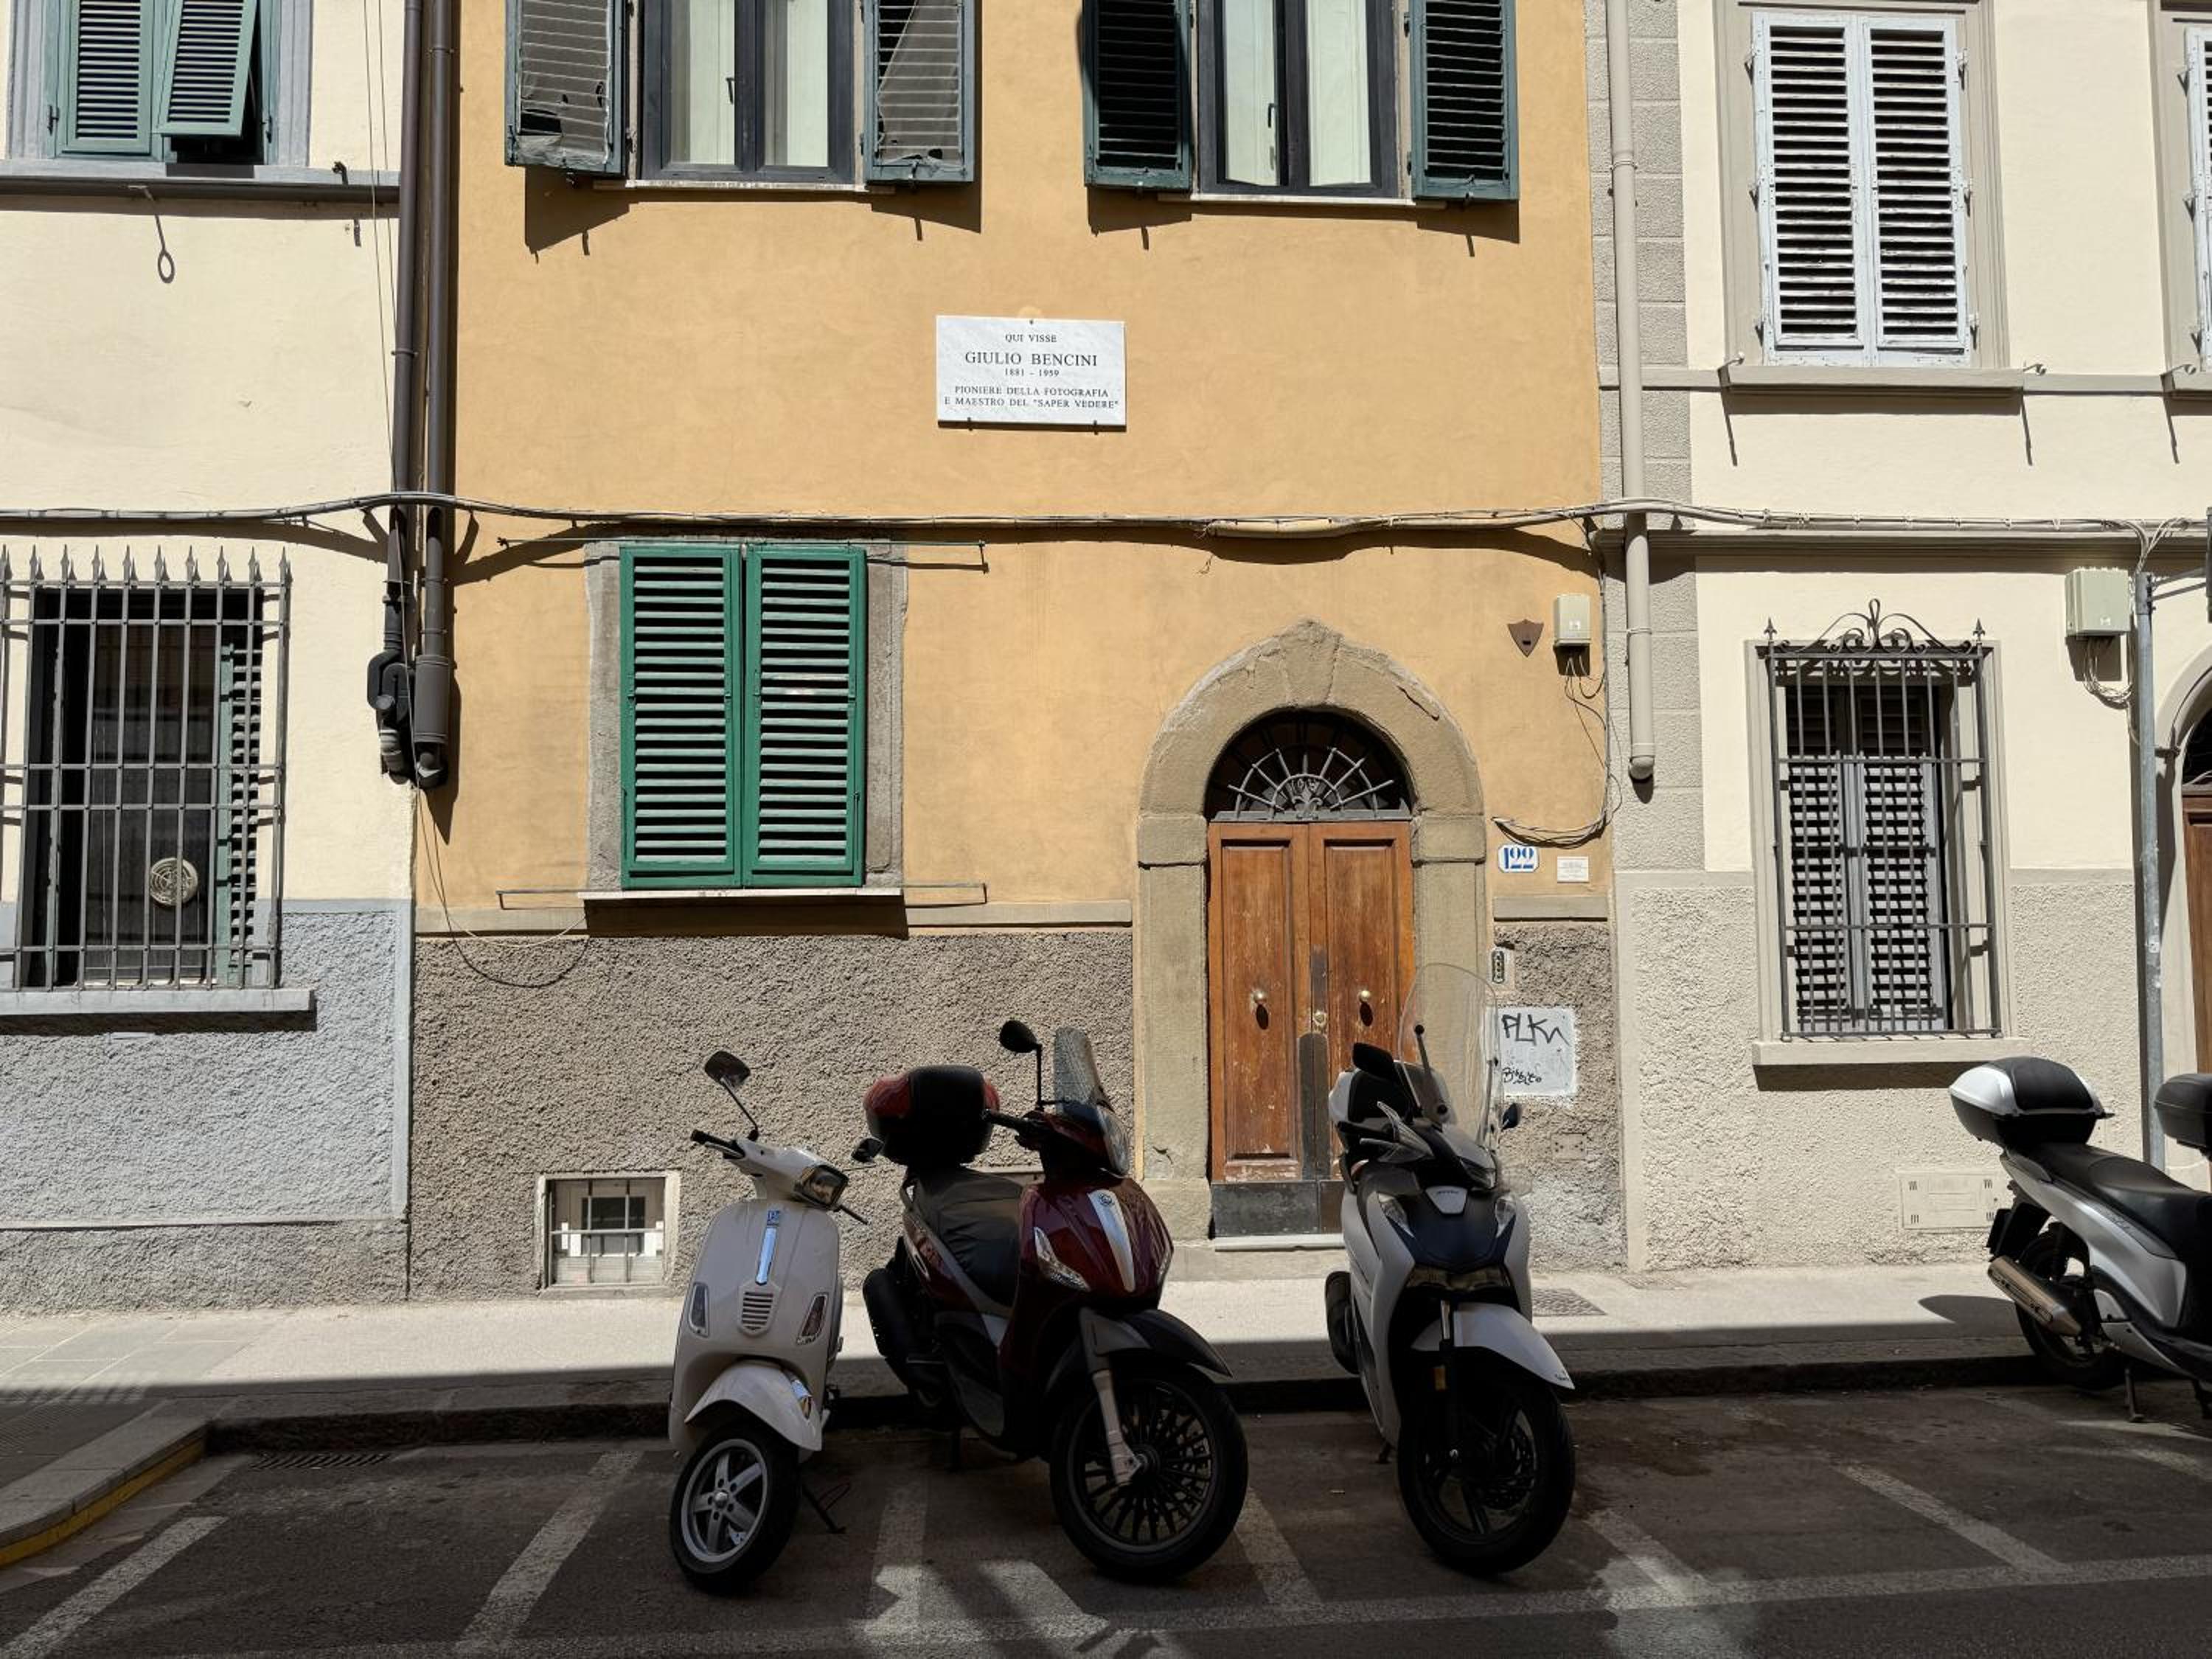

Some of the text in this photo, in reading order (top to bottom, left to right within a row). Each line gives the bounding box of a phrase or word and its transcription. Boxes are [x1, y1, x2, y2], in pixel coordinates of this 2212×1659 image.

[1005, 334, 1057, 343] QUI VISSE
[965, 352, 1097, 366] GIULIO BENCINI
[1005, 368, 1024, 376] 1881
[955, 386, 1108, 397] PIONIERE DELLA FOTOGRAFIA
[945, 397, 950, 405] E
[955, 397, 1004, 406] MAESTRO
[1503, 847, 1534, 869] 122
